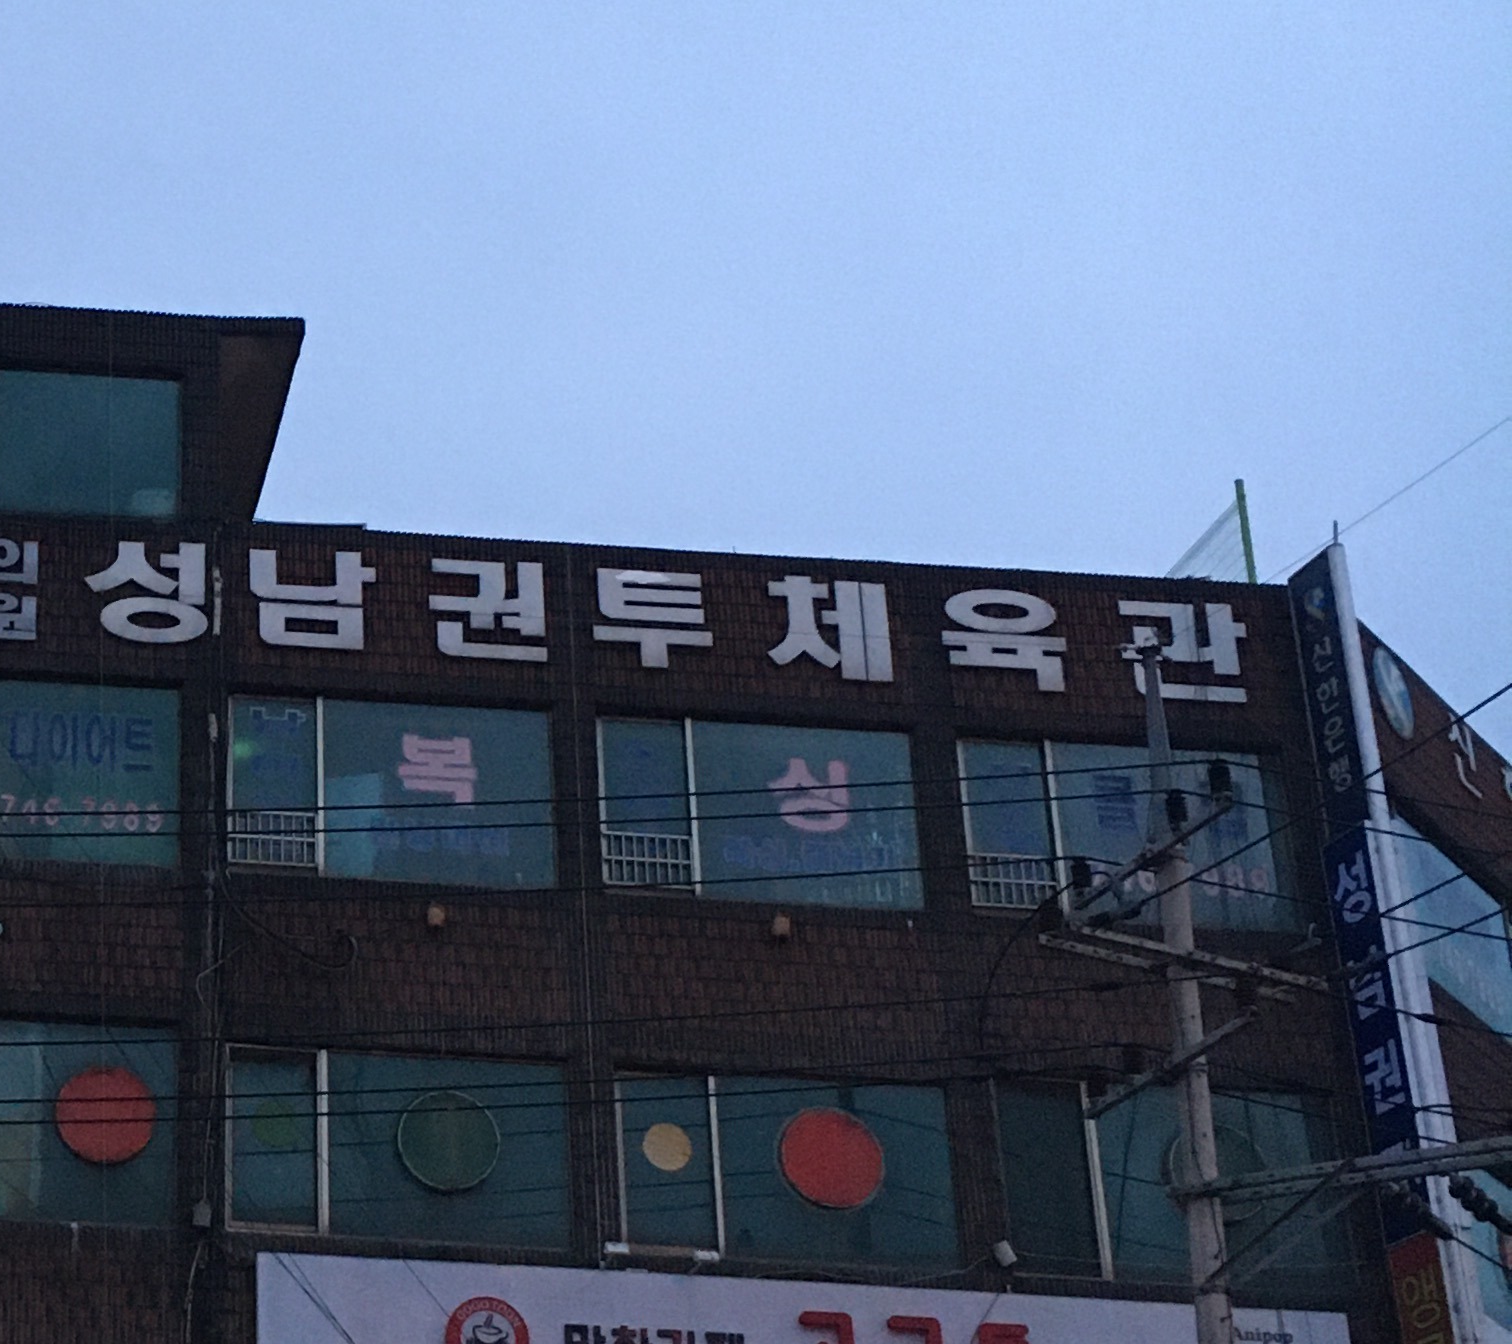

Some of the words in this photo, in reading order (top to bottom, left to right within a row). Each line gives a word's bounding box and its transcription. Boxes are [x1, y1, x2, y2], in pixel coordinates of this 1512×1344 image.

[84, 539, 1248, 704] 성남권투체육관
[398, 733, 477, 810] 복
[766, 757, 849, 832] 싱
